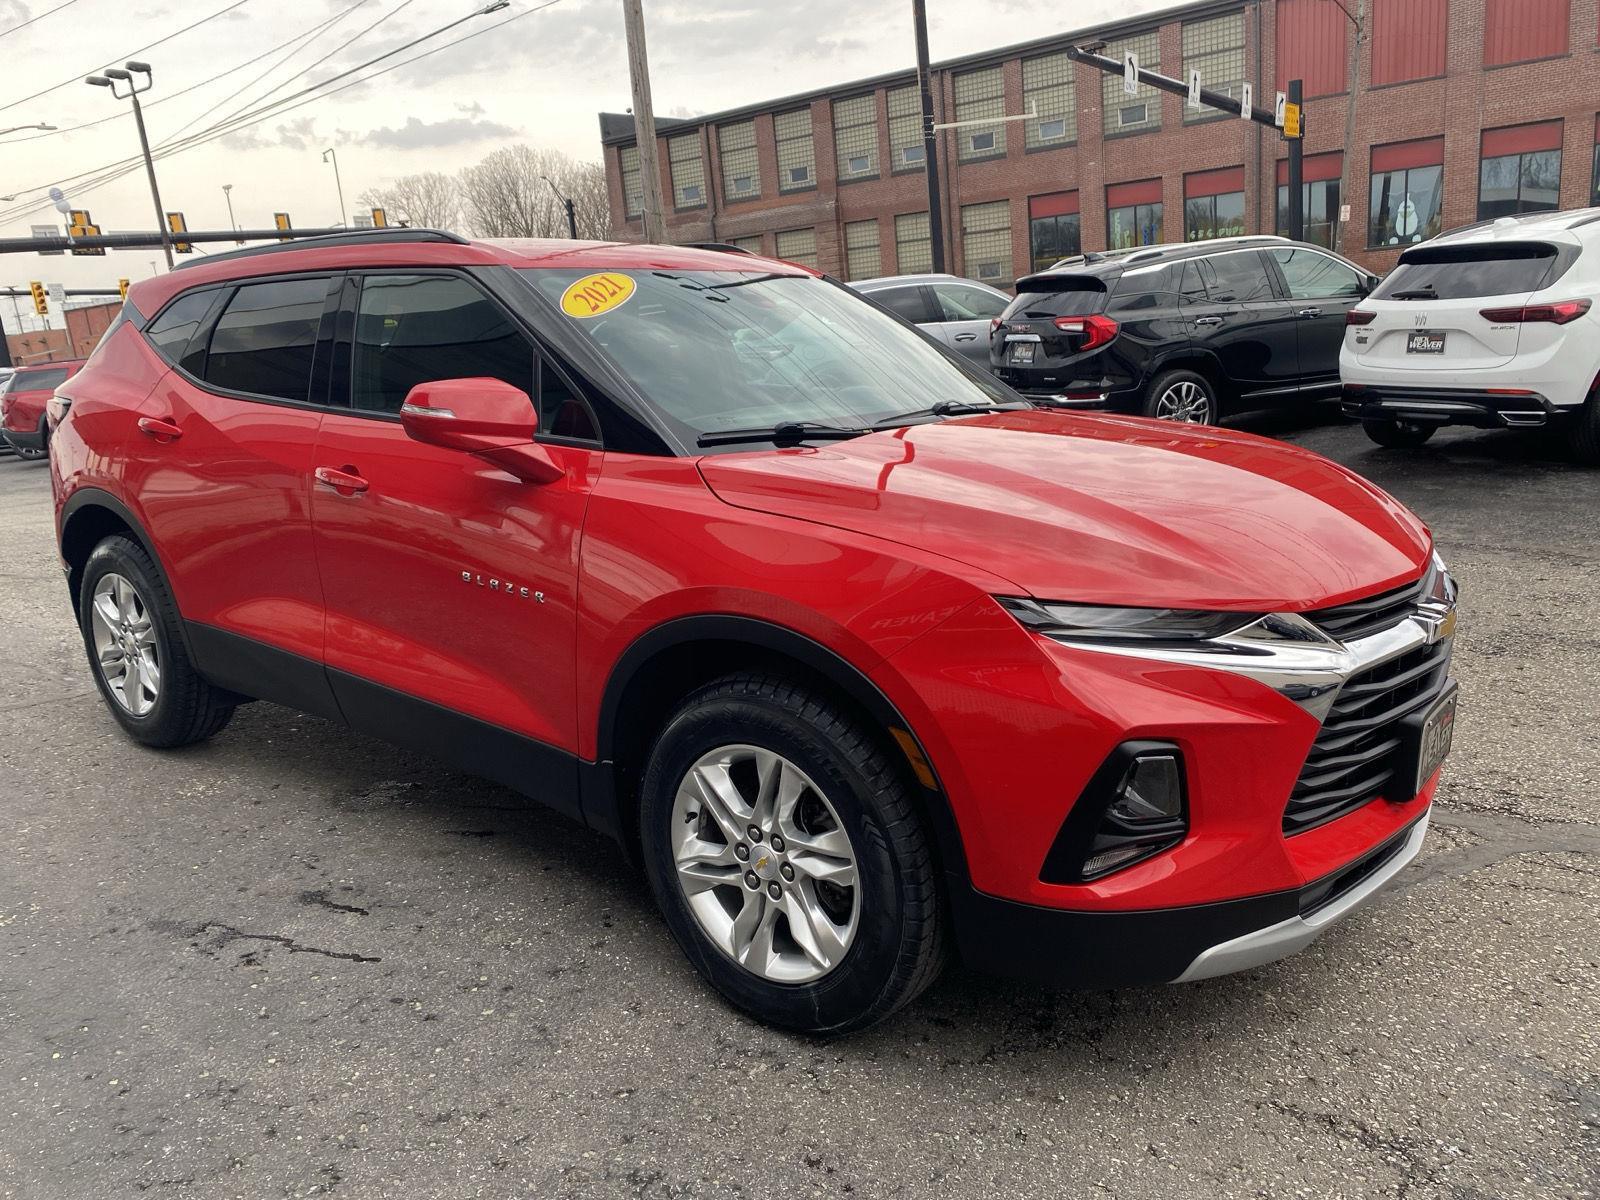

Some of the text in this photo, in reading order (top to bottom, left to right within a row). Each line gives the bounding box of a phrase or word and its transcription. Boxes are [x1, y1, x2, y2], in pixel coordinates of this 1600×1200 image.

[573, 275, 625, 312] 2021
[1409, 340, 1443, 350] WEAVER
[462, 571, 545, 604] BLAZER
